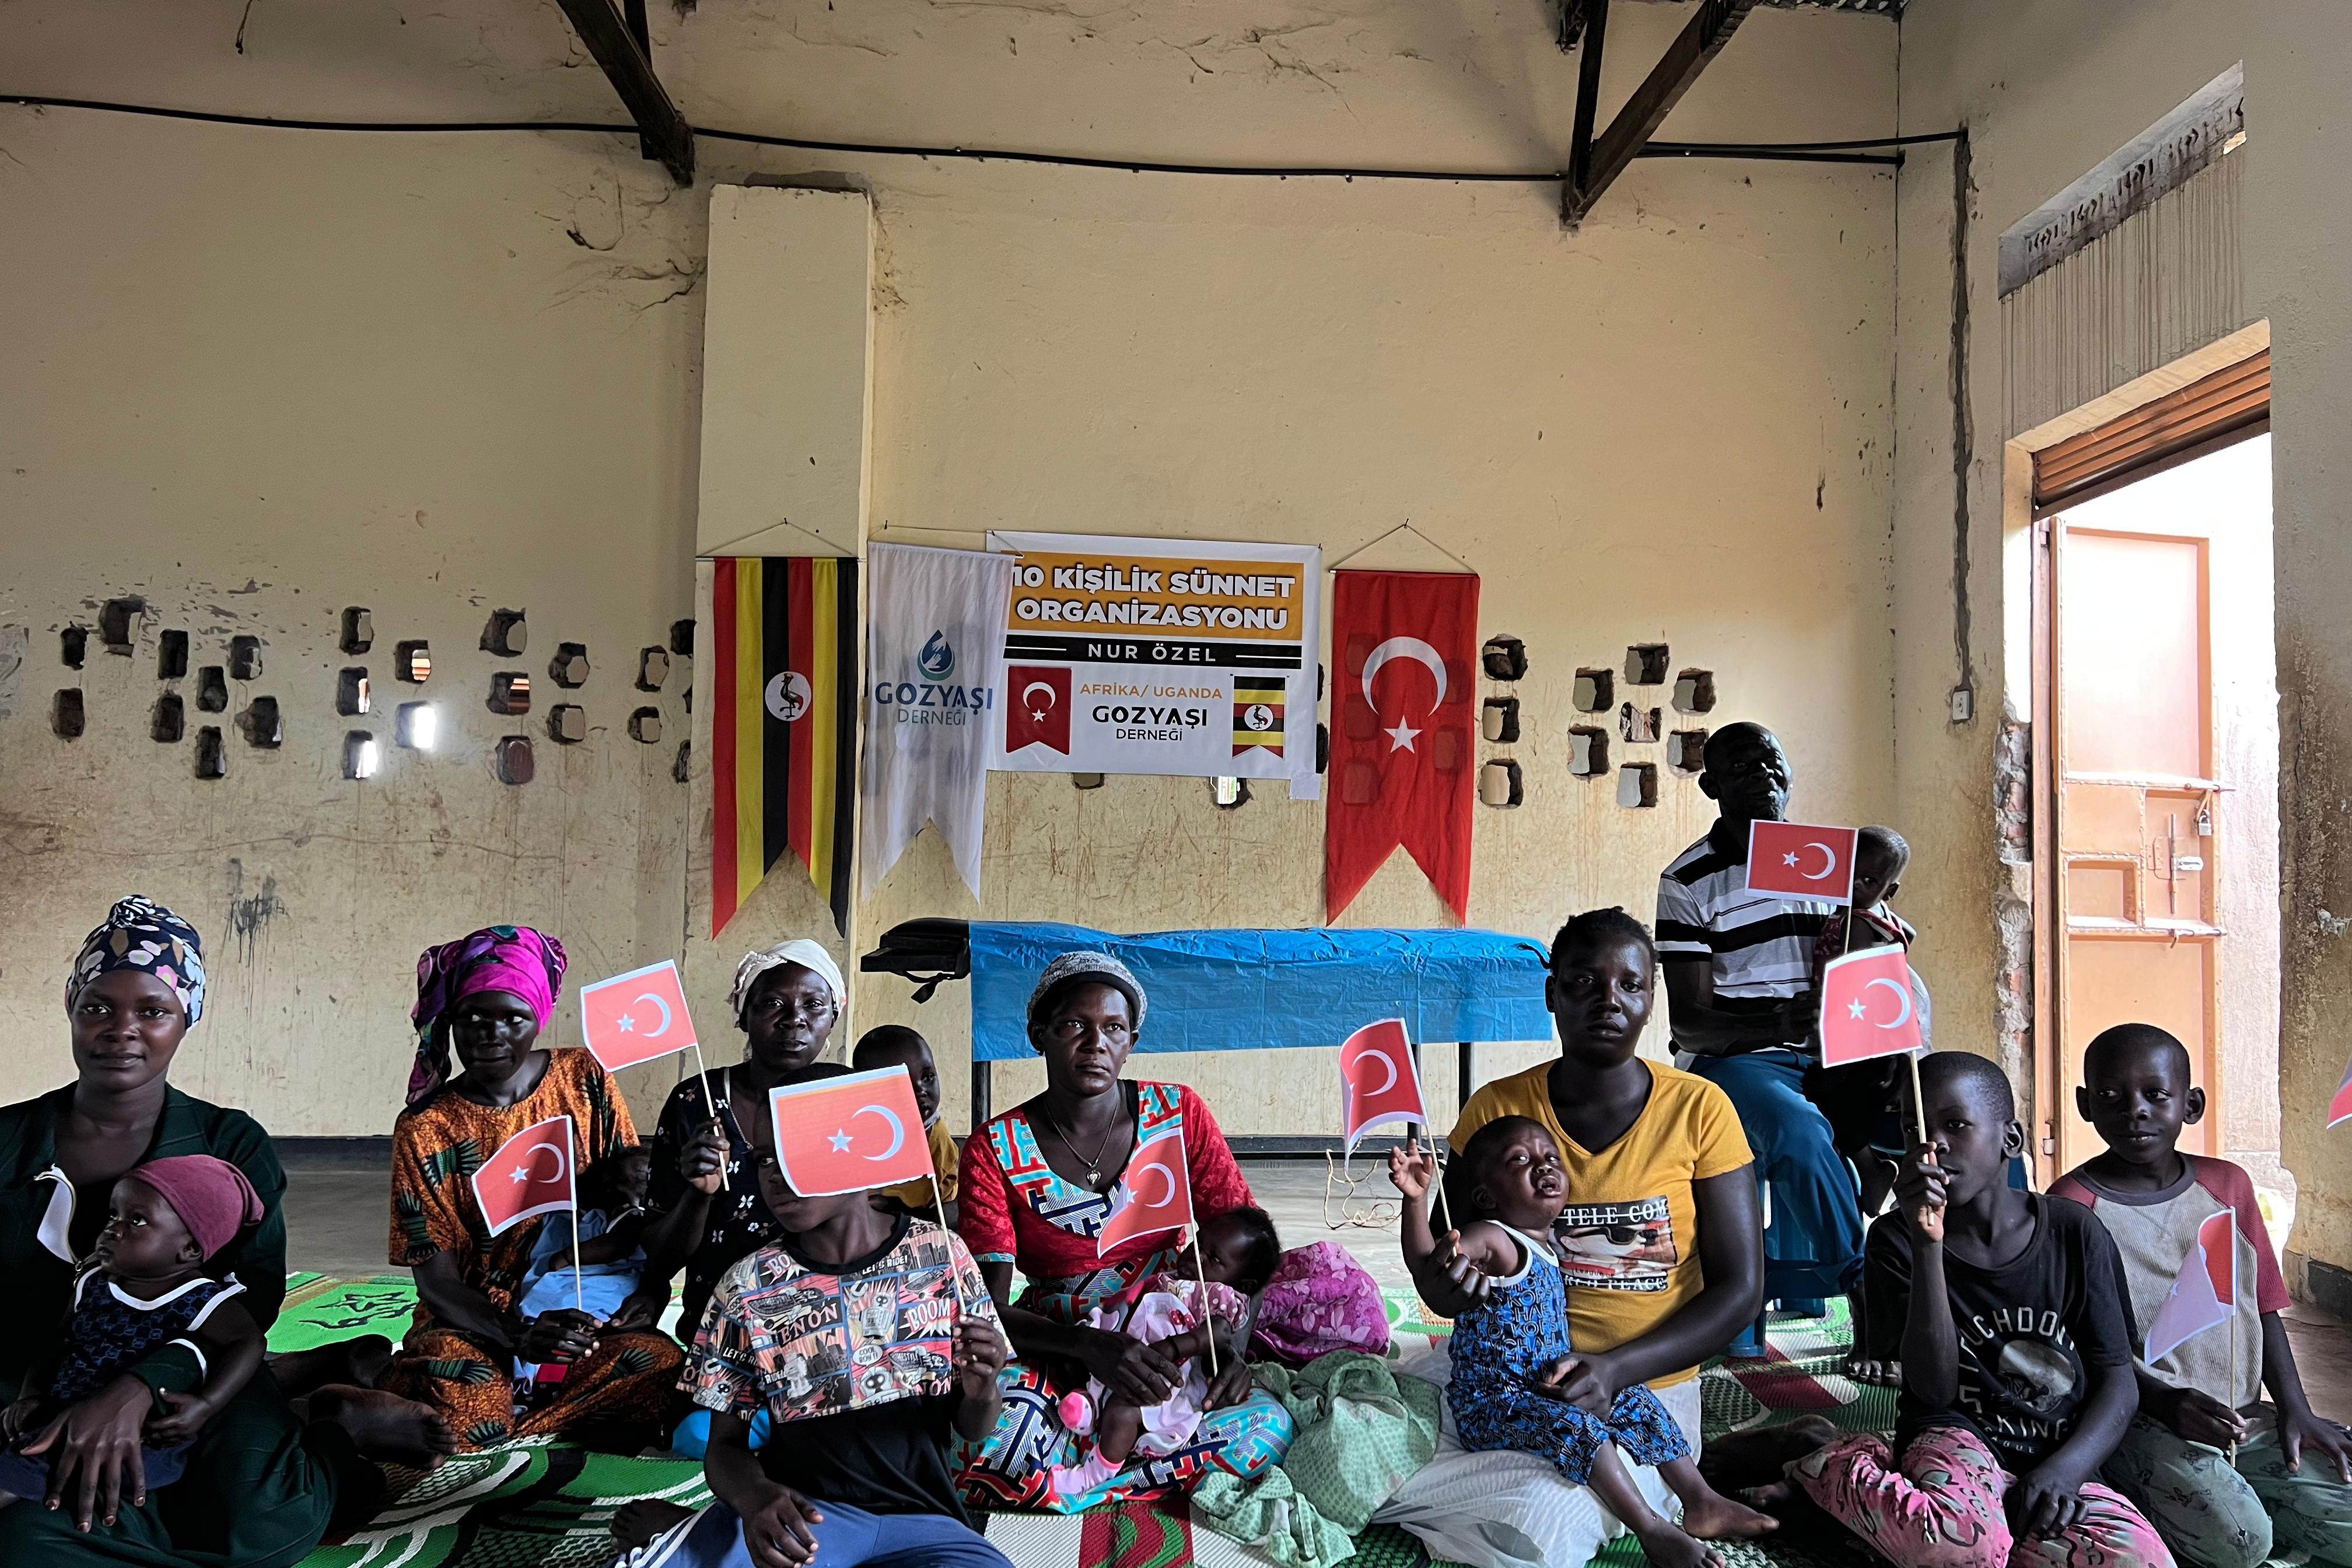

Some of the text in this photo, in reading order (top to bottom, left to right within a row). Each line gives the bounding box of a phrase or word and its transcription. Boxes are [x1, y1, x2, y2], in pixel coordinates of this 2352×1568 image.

[1054, 564, 1162, 594] KİŞİLİK
[1169, 569, 1296, 598] SÜNNET
[1017, 598, 1287, 630] ORGANİZASYONU
[1088, 643, 1216, 662] NUR ÖZEL
[1153, 686, 1223, 699] UGANDA
[1564, 1207, 1619, 1226] TELE
[908, 1298, 950, 1331] BOOM
